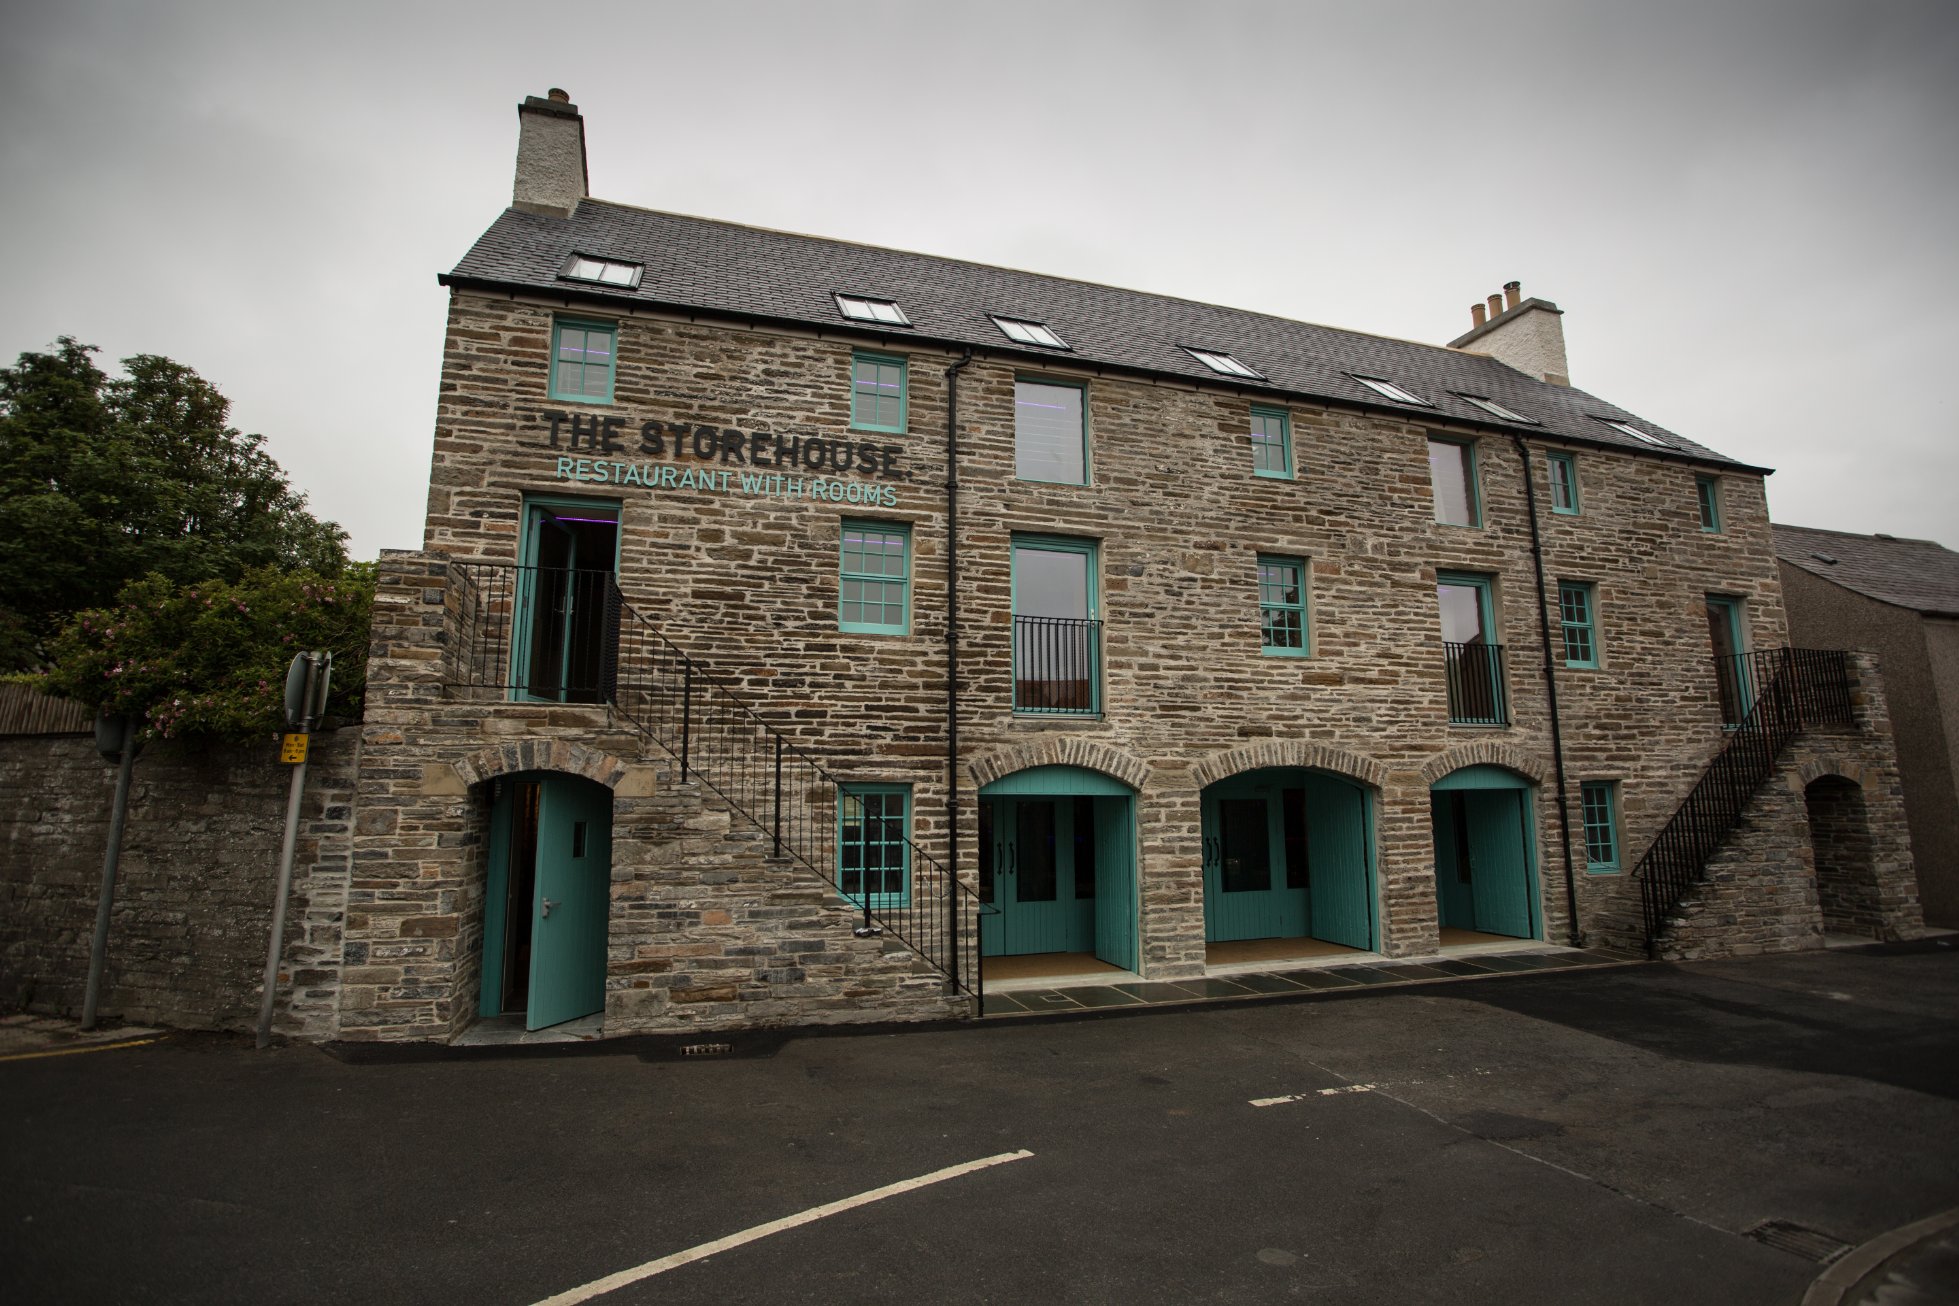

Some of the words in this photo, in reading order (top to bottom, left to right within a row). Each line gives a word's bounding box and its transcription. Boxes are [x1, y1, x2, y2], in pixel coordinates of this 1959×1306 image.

[543, 410, 626, 451] THE
[557, 456, 733, 492] RESTAURANT
[741, 473, 803, 499] WITH
[812, 479, 898, 507] ROOMS
